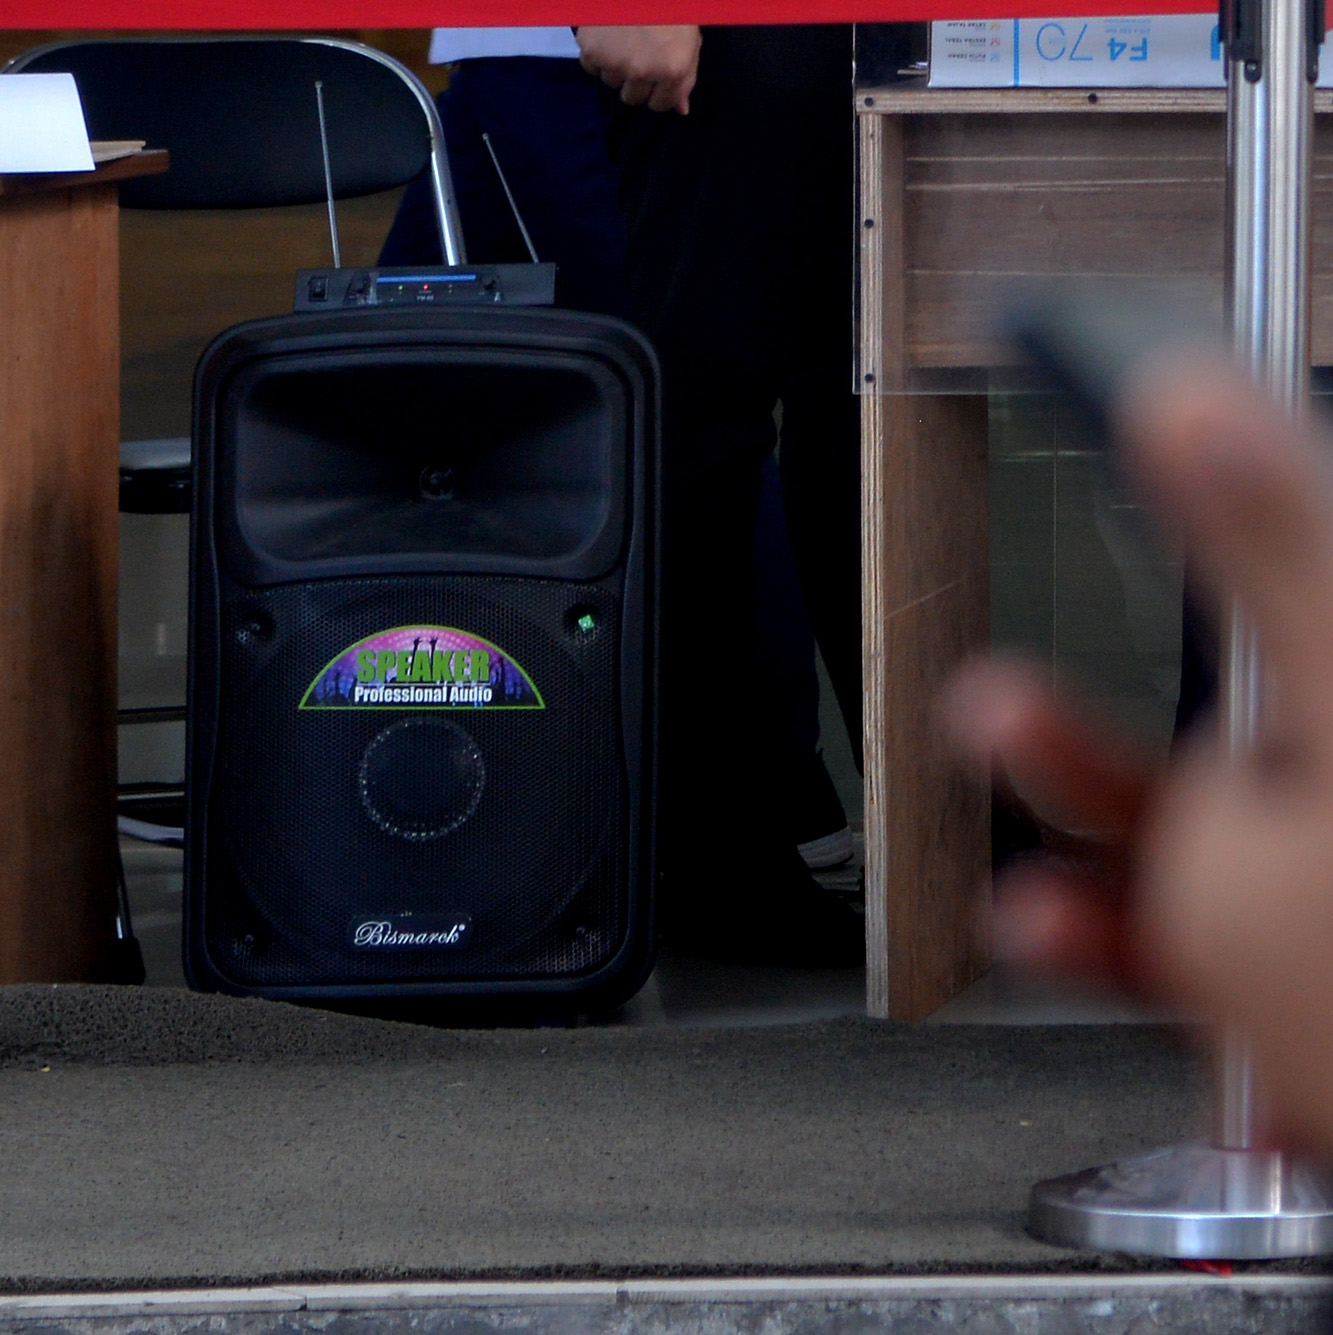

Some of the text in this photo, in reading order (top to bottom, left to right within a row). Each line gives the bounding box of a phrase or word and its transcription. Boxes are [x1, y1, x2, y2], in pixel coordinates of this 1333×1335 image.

[1037, 22, 1093, 62] 70
[1107, 38, 1148, 61] F4
[356, 650, 490, 682] SPEAKER
[355, 686, 493, 703] Professional Audio
